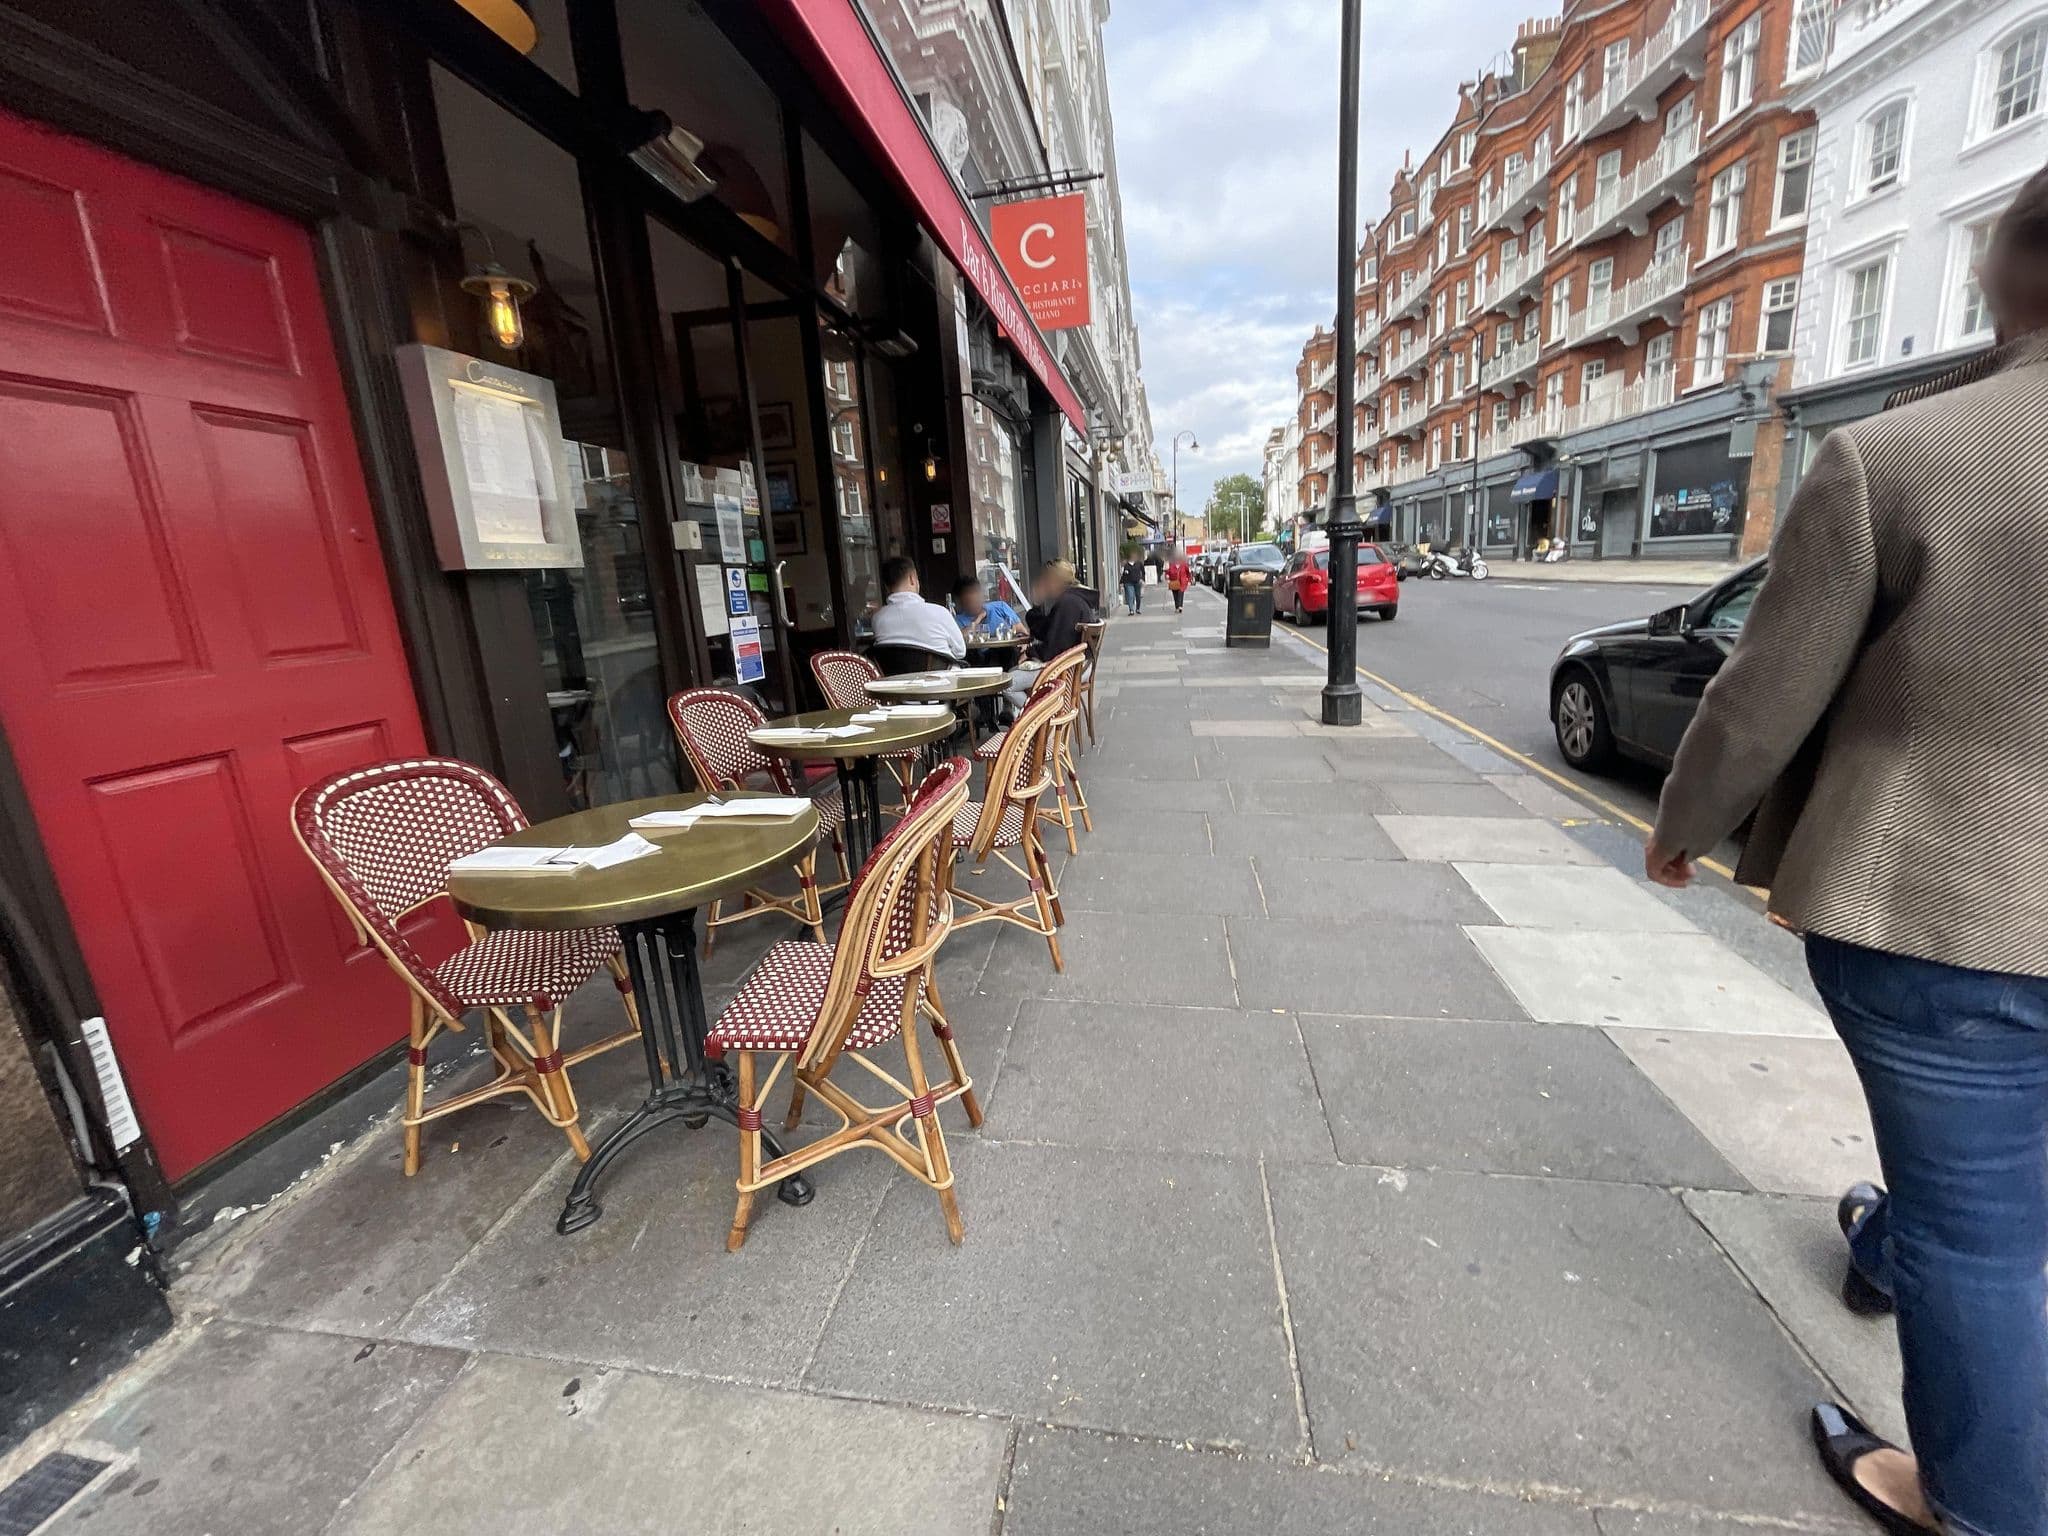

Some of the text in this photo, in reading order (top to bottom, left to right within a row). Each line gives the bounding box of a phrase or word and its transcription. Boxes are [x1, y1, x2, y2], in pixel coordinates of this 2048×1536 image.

[960, 217, 981, 284] Bar
[1020, 223, 1056, 269] C
[1032, 296, 1077, 311] RISTORANTE
